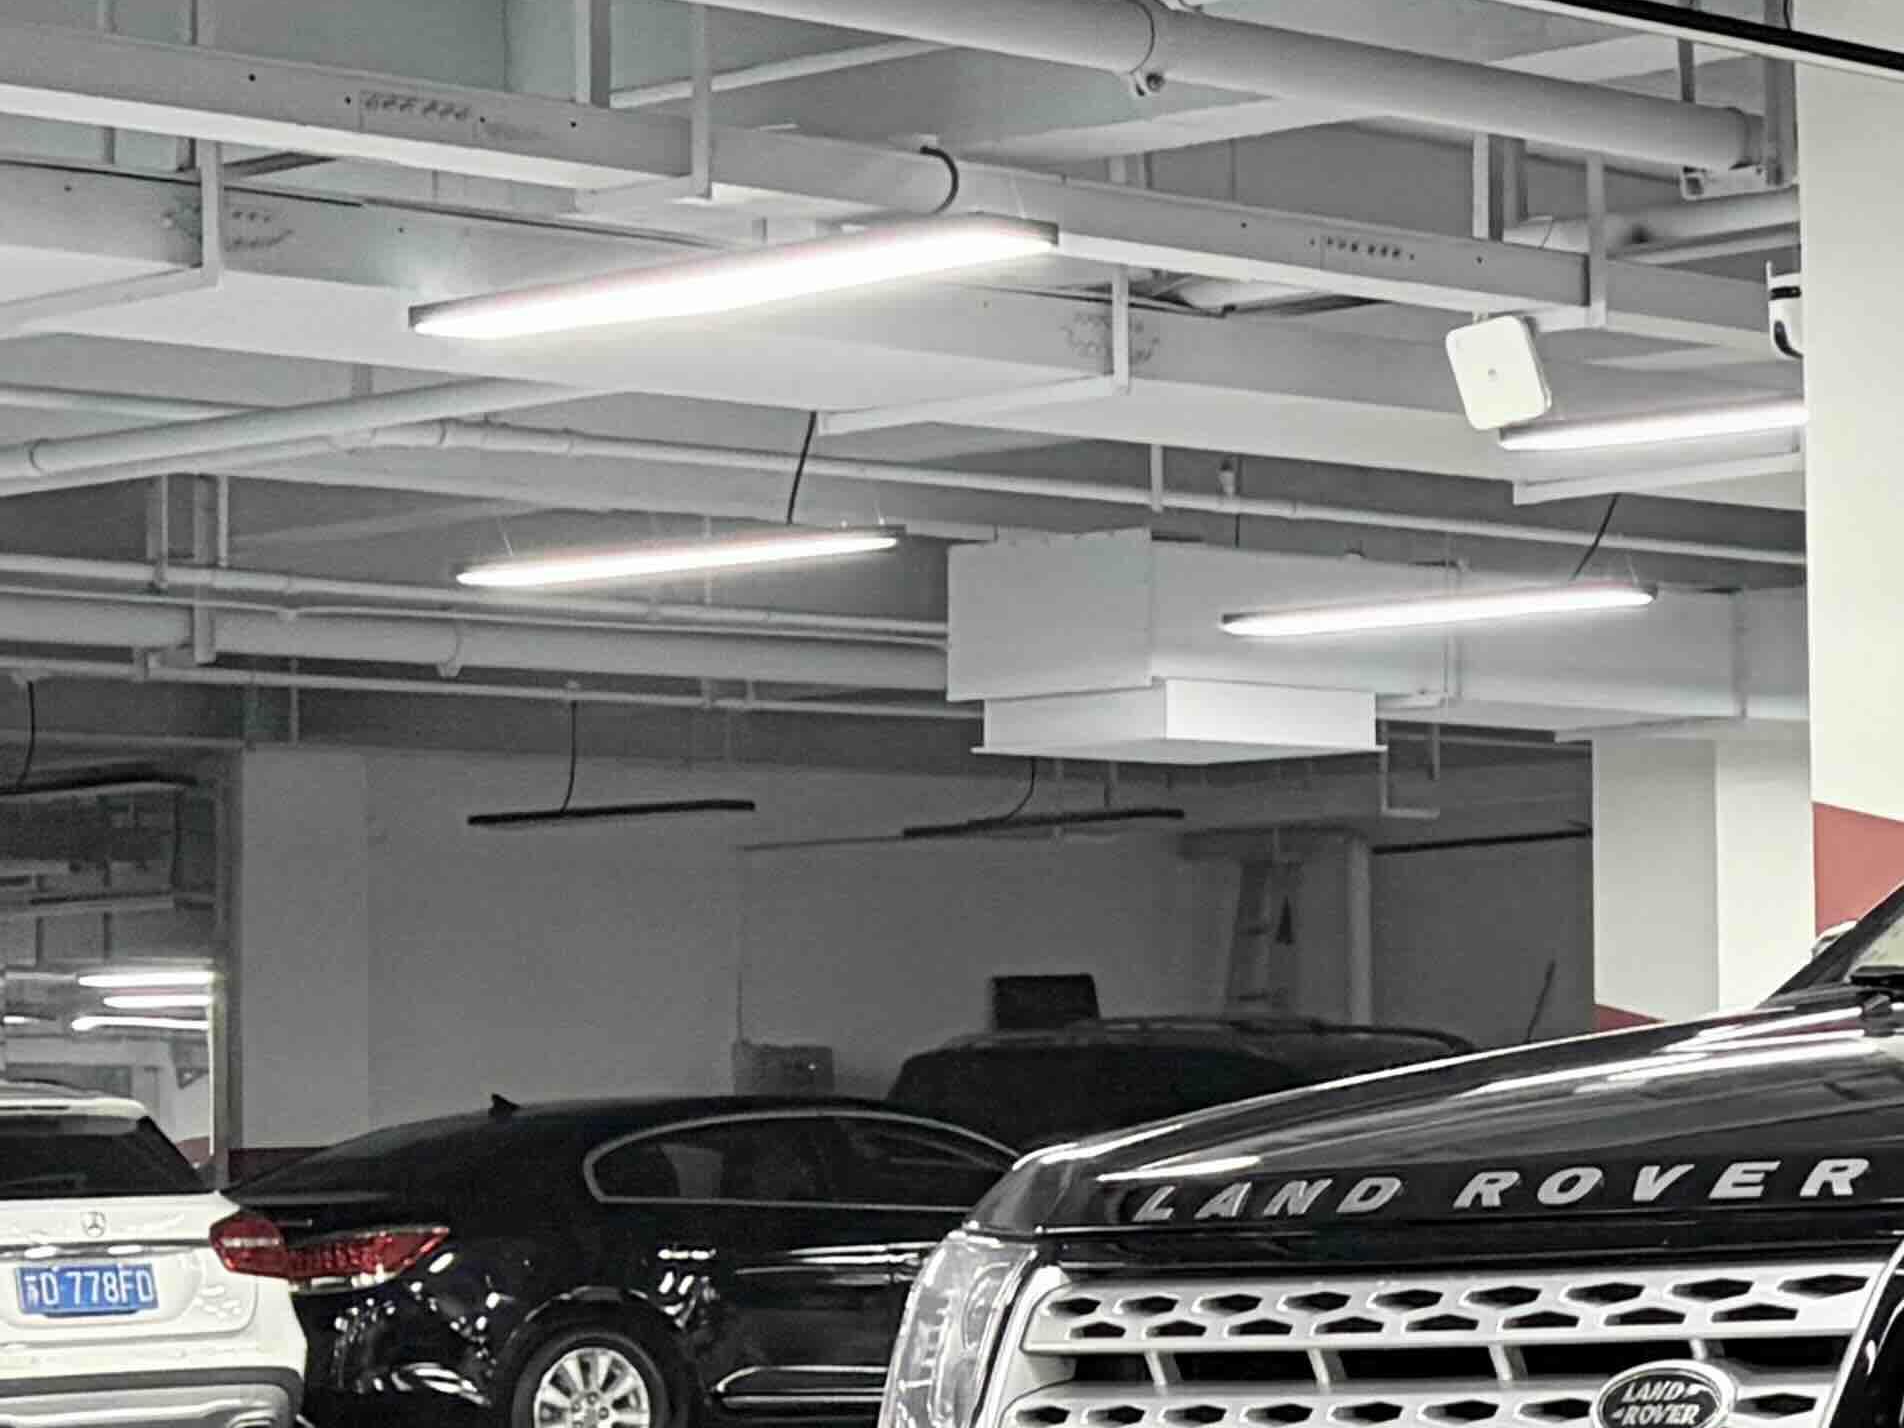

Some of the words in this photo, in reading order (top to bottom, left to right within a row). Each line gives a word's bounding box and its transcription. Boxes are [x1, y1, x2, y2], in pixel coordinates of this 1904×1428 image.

[1132, 1176, 1402, 1222] LAND
[1453, 1158, 1869, 1209] ROVER
[1621, 1380, 1685, 1403] LAND
[1620, 1403, 1701, 1426] ROVER
